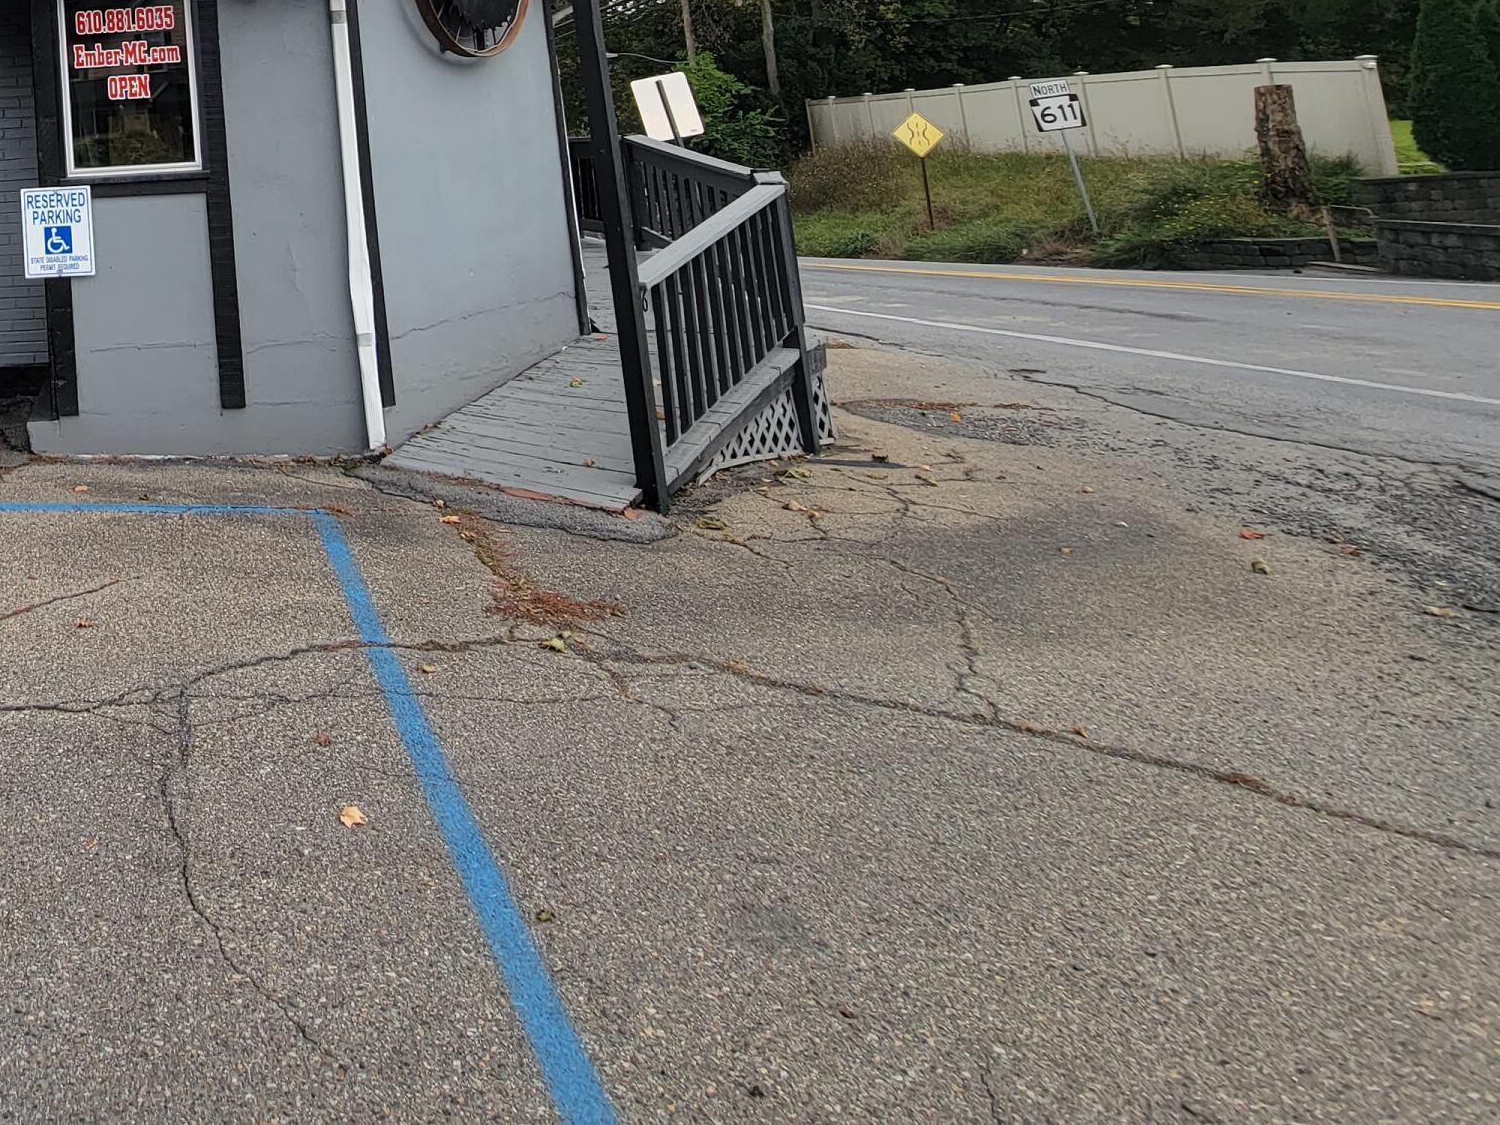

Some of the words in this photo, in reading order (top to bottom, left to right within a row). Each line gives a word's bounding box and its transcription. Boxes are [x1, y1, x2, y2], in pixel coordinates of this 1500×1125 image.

[75, 6, 174, 34] 610.881.6035
[108, 74, 151, 100] OPEN
[1033, 83, 1067, 95] NORTH
[1041, 103, 1077, 123] 611
[27, 192, 85, 209] RESERVED
[33, 209, 81, 225] PARKING
